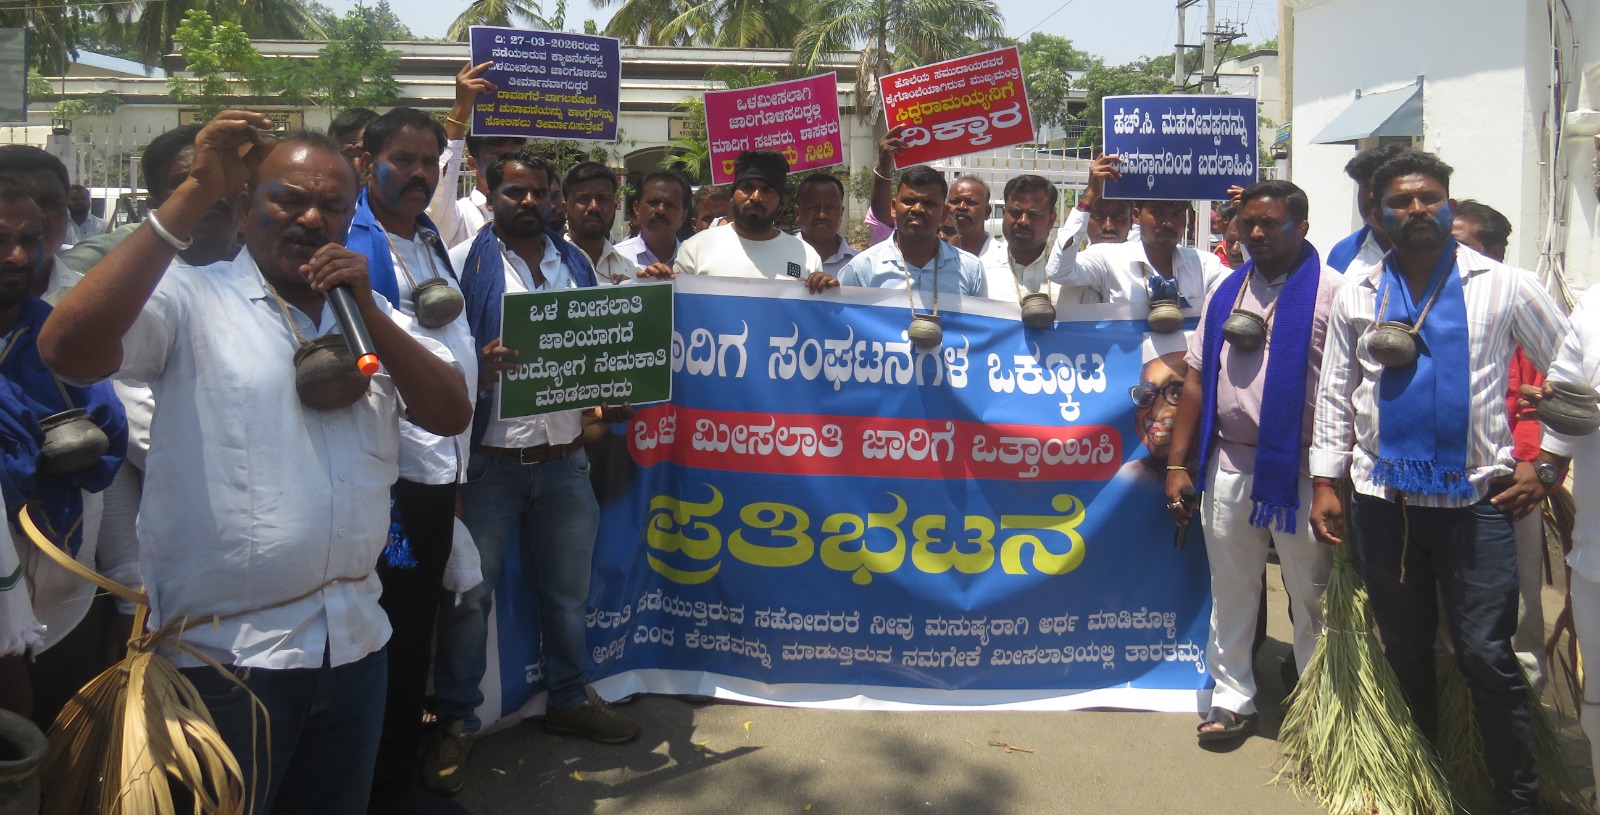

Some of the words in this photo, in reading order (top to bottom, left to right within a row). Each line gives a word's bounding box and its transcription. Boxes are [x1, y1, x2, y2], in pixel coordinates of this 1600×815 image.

[551, 65, 608, 79] ಜಾರಿಗೊಳಿಸಲು
[886, 79, 966, 107] ಕೈಗೊಂಬೆಯಾಗಿರುವ
[969, 67, 1019, 87] ಮುಖ್ಯಮಂತ್ರಿ
[895, 72, 930, 88] ಹೊಲೆಯ
[934, 55, 1004, 80] ಸಮುದಾಯದವರ
[729, 103, 822, 130] ಜಾರಿಗೊಳಿಸದಿದ್ದಲ್ಲಿ
[737, 87, 812, 111] ಒಳಮೀಸಲಾಗಿ
[896, 81, 1016, 124] ಸಿದ್ದರಾಮಯ್ಯನಿಗೆ
[712, 135, 750, 153] ಮಾದಿಗ
[754, 130, 796, 148] ಸಚಿವರು,
[800, 120, 839, 141] ಶಾಸಕರು
[1161, 107, 1248, 147] ಮಹದೇವಪ್ಪನನ್ನು
[805, 141, 834, 163] ನೀಡಿ
[529, 298, 559, 322] ಒಳ
[567, 294, 643, 319] ಮೀಸಲಾತಿ
[539, 321, 634, 350] ಜಾರಿಯಾಗದೆ
[507, 354, 586, 387] ಉದ್ಯೋಗ
[594, 348, 667, 373] ನೇಮಕಾತಿ
[768, 321, 971, 392] ಸಂಘಟನೆಗಳ
[987, 341, 1107, 422] ಒಕ್ಕೂಟ
[536, 377, 633, 407] ಮಾಡಬಾರದು
[634, 408, 677, 451] ಒಳ
[692, 415, 844, 457] ಮೀಸಲಾತಿ
[861, 422, 955, 462] ಜಾರಿಗೆ
[971, 432, 1115, 478] ಒತ್ತಾಯಿಸಿ
[646, 482, 1086, 585] ಪ್ರತಿಭಟನೆ
[754, 606, 860, 633] ಸಹೋದರರೆ
[870, 612, 914, 641] ನೀವು
[925, 615, 1029, 646] ಮನುಷ್ಯರಾಗಿ
[1038, 611, 1079, 637] ಅರ್ಥ
[1087, 606, 1177, 639] ಮಾಡಿಕೊಳ್ಳಿ
[633, 625, 675, 647] ಎಂದ
[684, 628, 772, 669] ಕೆಲಸವನ್ನು
[782, 641, 892, 665] ಮಾಡುತ್ತಿರುವ
[902, 646, 983, 668] ನಮಗೇಕೆ
[990, 641, 1116, 670] ಮೀಸಲಾತಿಯಲ್ಲಿ
[1125, 640, 1205, 674] ತಾರತಮ್ಯ
